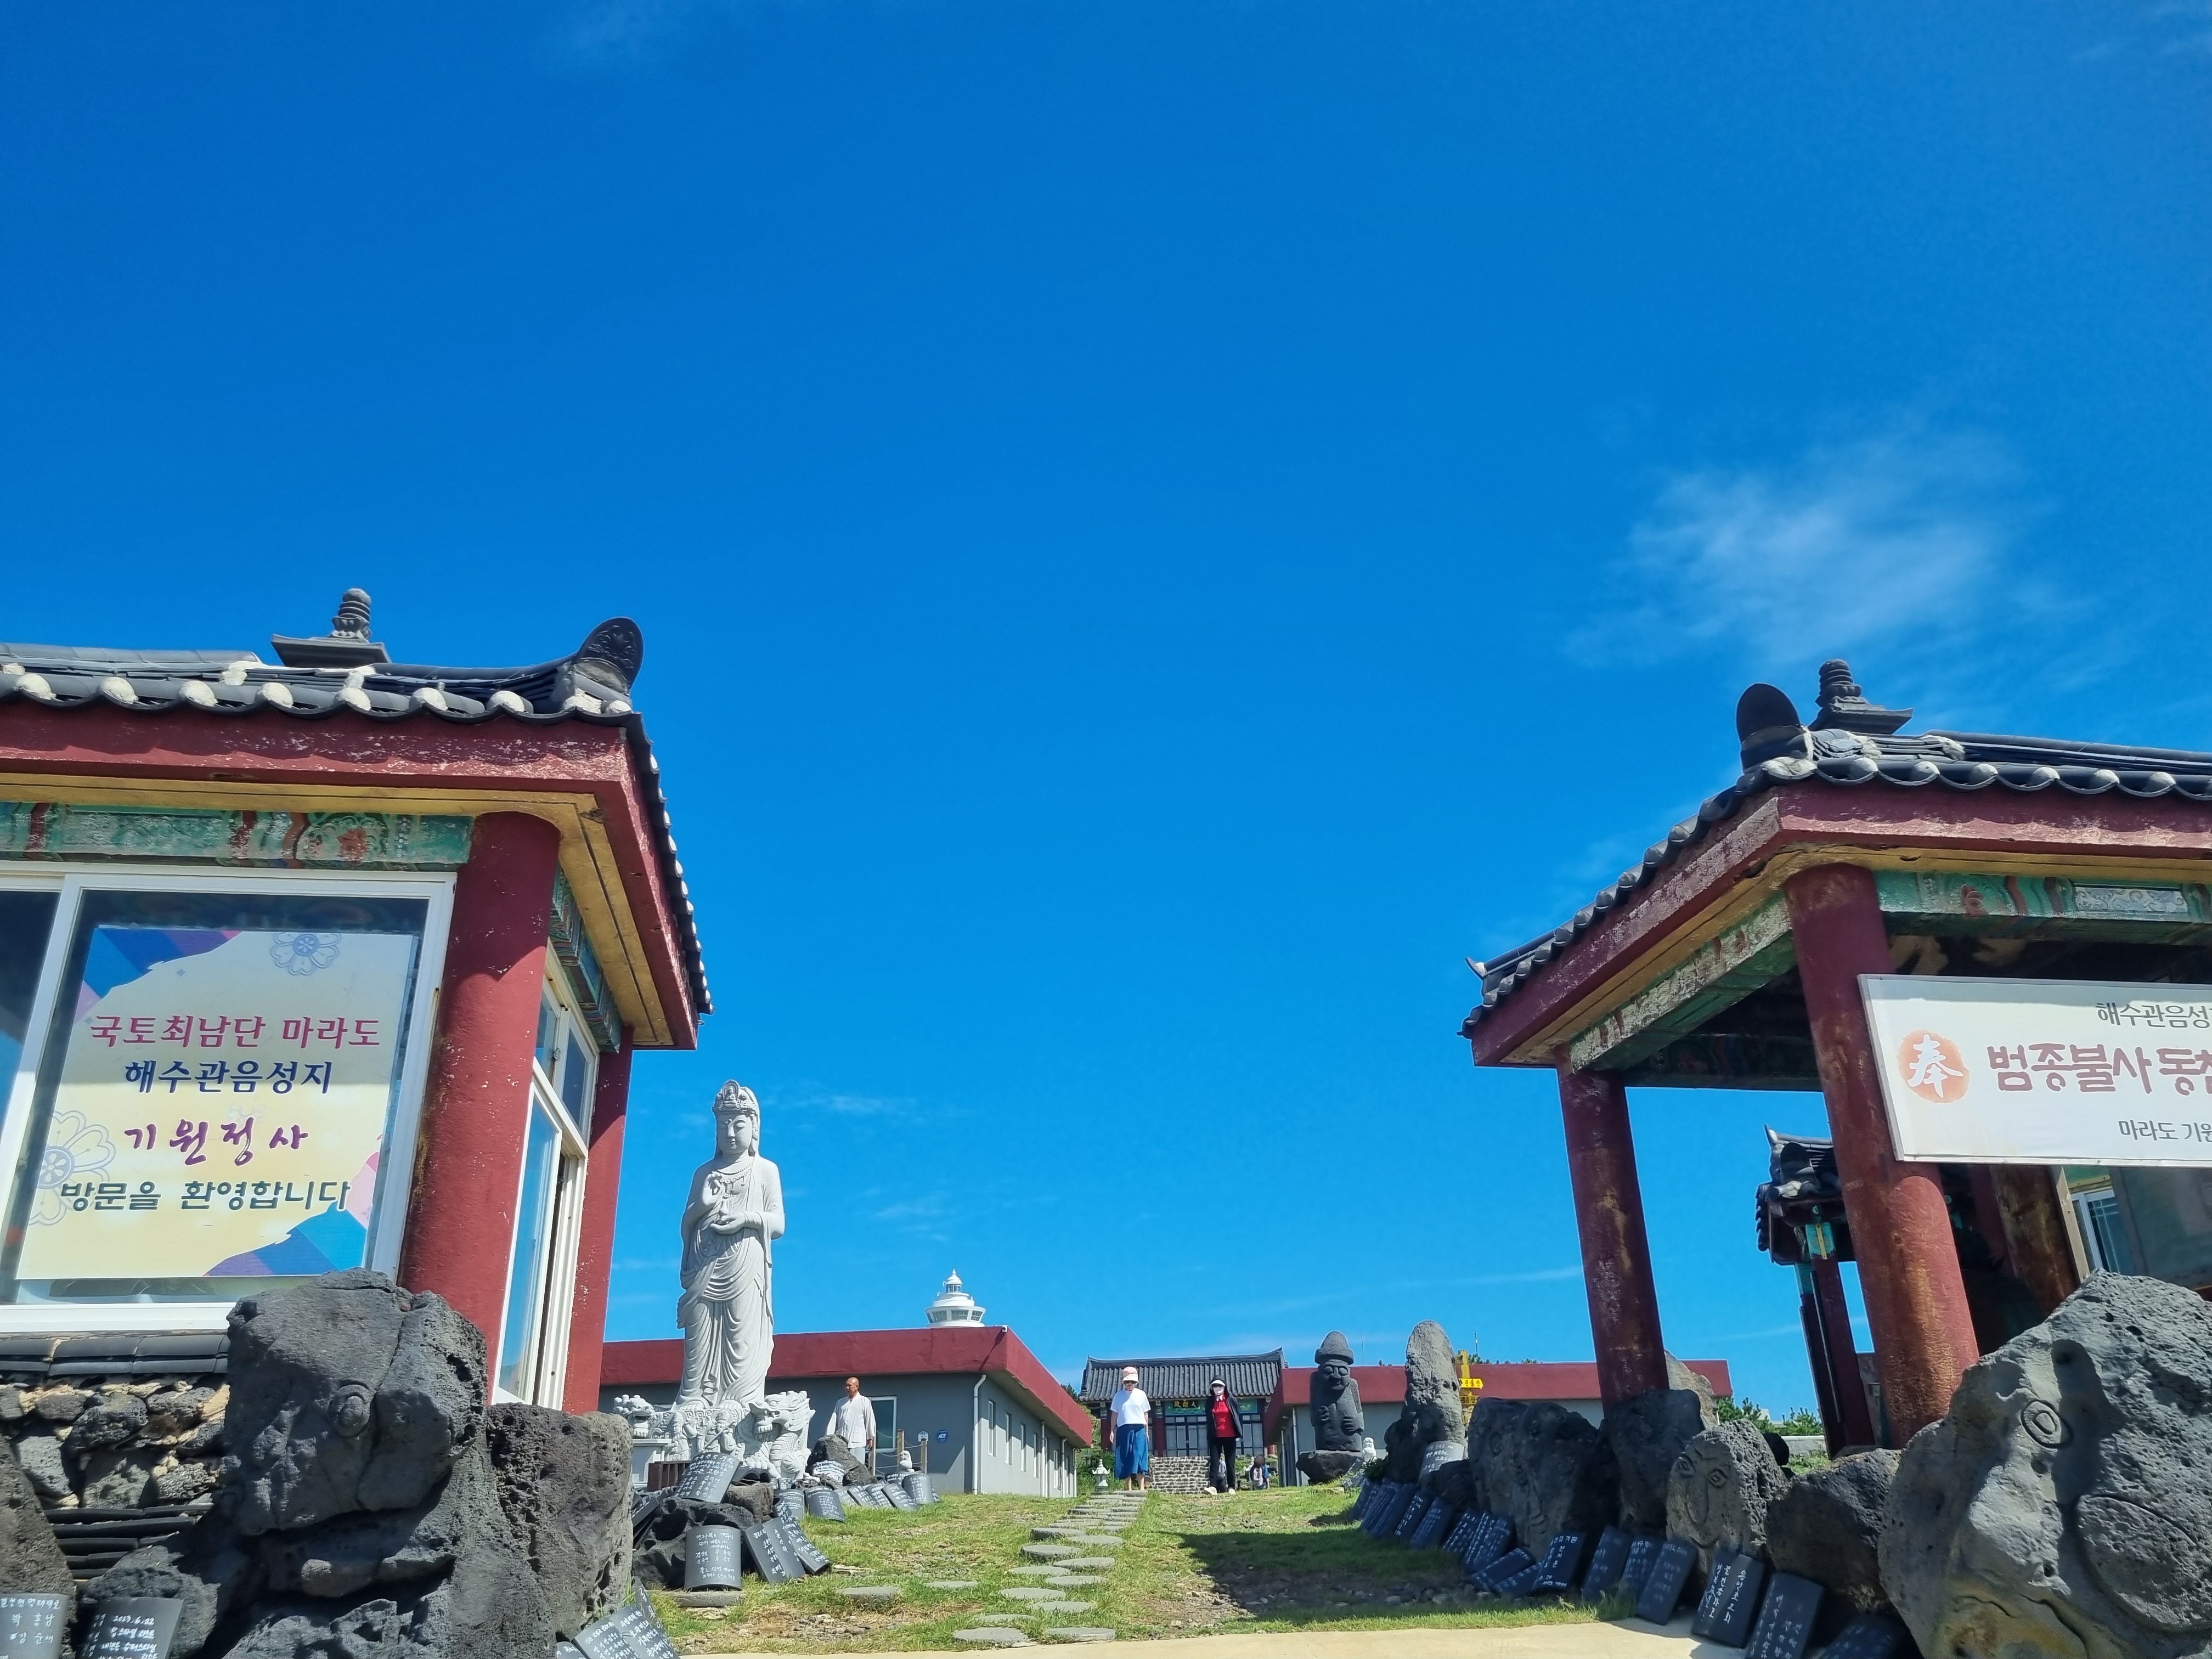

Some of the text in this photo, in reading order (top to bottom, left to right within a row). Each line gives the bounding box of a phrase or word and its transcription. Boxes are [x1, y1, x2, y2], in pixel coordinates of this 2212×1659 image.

[90, 1014, 381, 1049] 국토최남단 마라도
[2095, 1002, 2212, 1029] 해수관음성
[124, 1059, 334, 1094] 해수관음성지
[1986, 1043, 2153, 1094] 범종불사
[123, 1118, 309, 1166] 기원정사
[2118, 1119, 2179, 1142] 마라도
[60, 1180, 352, 1212] 방문을 환영합니다
